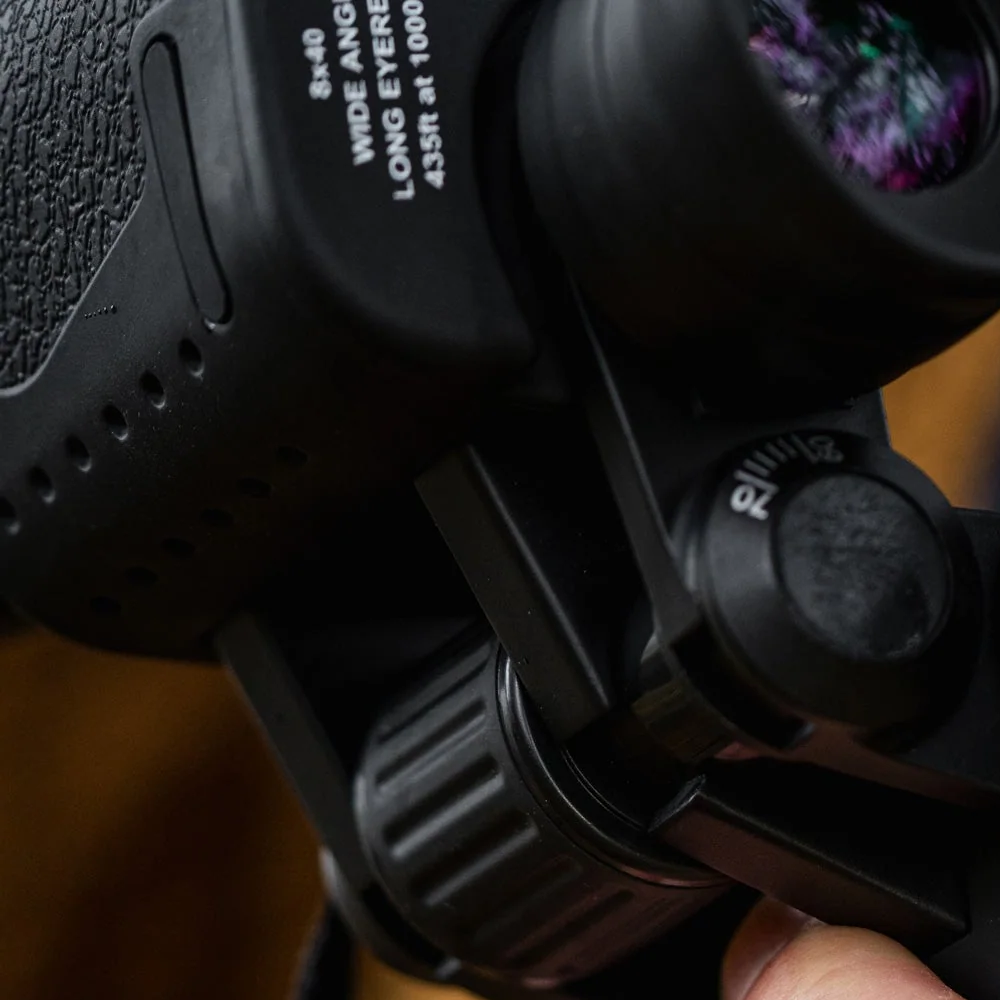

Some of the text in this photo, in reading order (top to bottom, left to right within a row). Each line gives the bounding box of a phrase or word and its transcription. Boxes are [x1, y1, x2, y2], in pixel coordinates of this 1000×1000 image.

[302, 28, 332, 100] 8x40
[332, 0, 375, 166] WIDE ANG
[413, 75, 436, 106] at
[381, 107, 415, 200] LONG
[417, 112, 446, 190] 435ft
